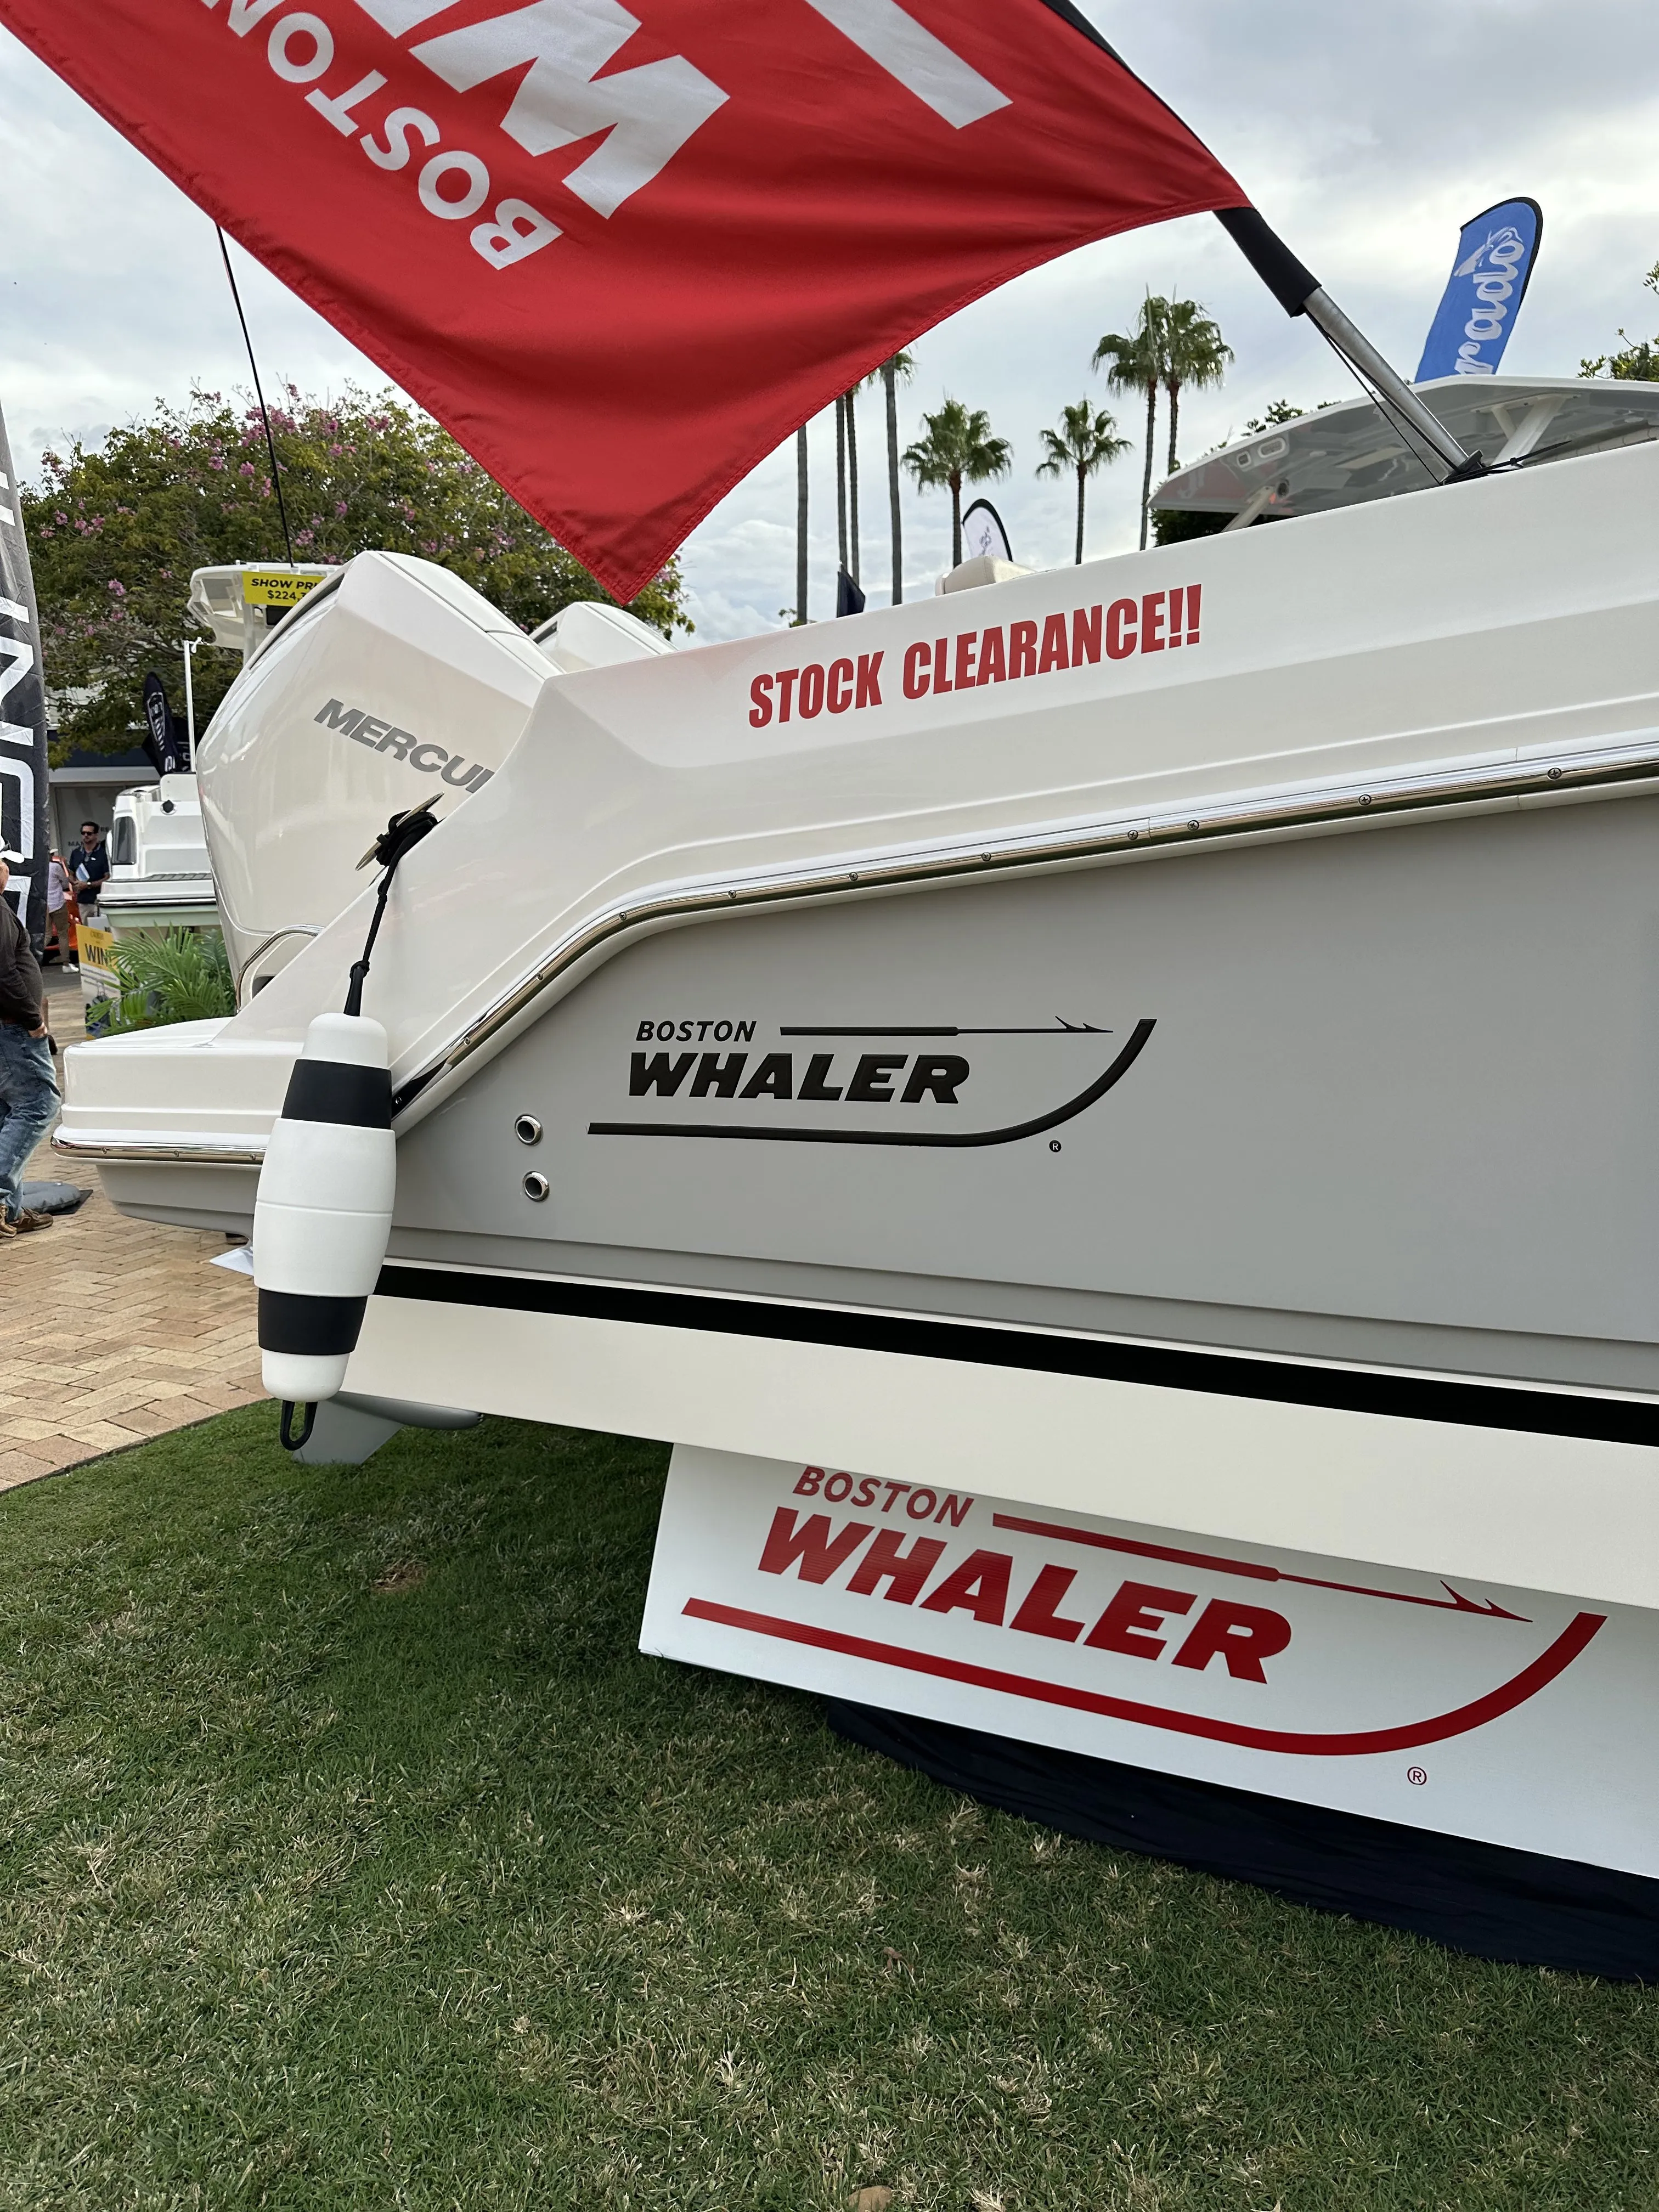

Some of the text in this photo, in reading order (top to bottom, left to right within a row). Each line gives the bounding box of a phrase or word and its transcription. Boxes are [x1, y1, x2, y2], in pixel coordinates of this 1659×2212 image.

[251, 578, 294, 589] SHOW
[749, 584, 1201, 728] STOCK CLEARANCE!!
[636, 1020, 757, 1042] BOSTON
[629, 1052, 970, 1104] WHALER
[792, 1466, 975, 1528] BOSTON
[758, 1506, 1291, 1684] WHALER
